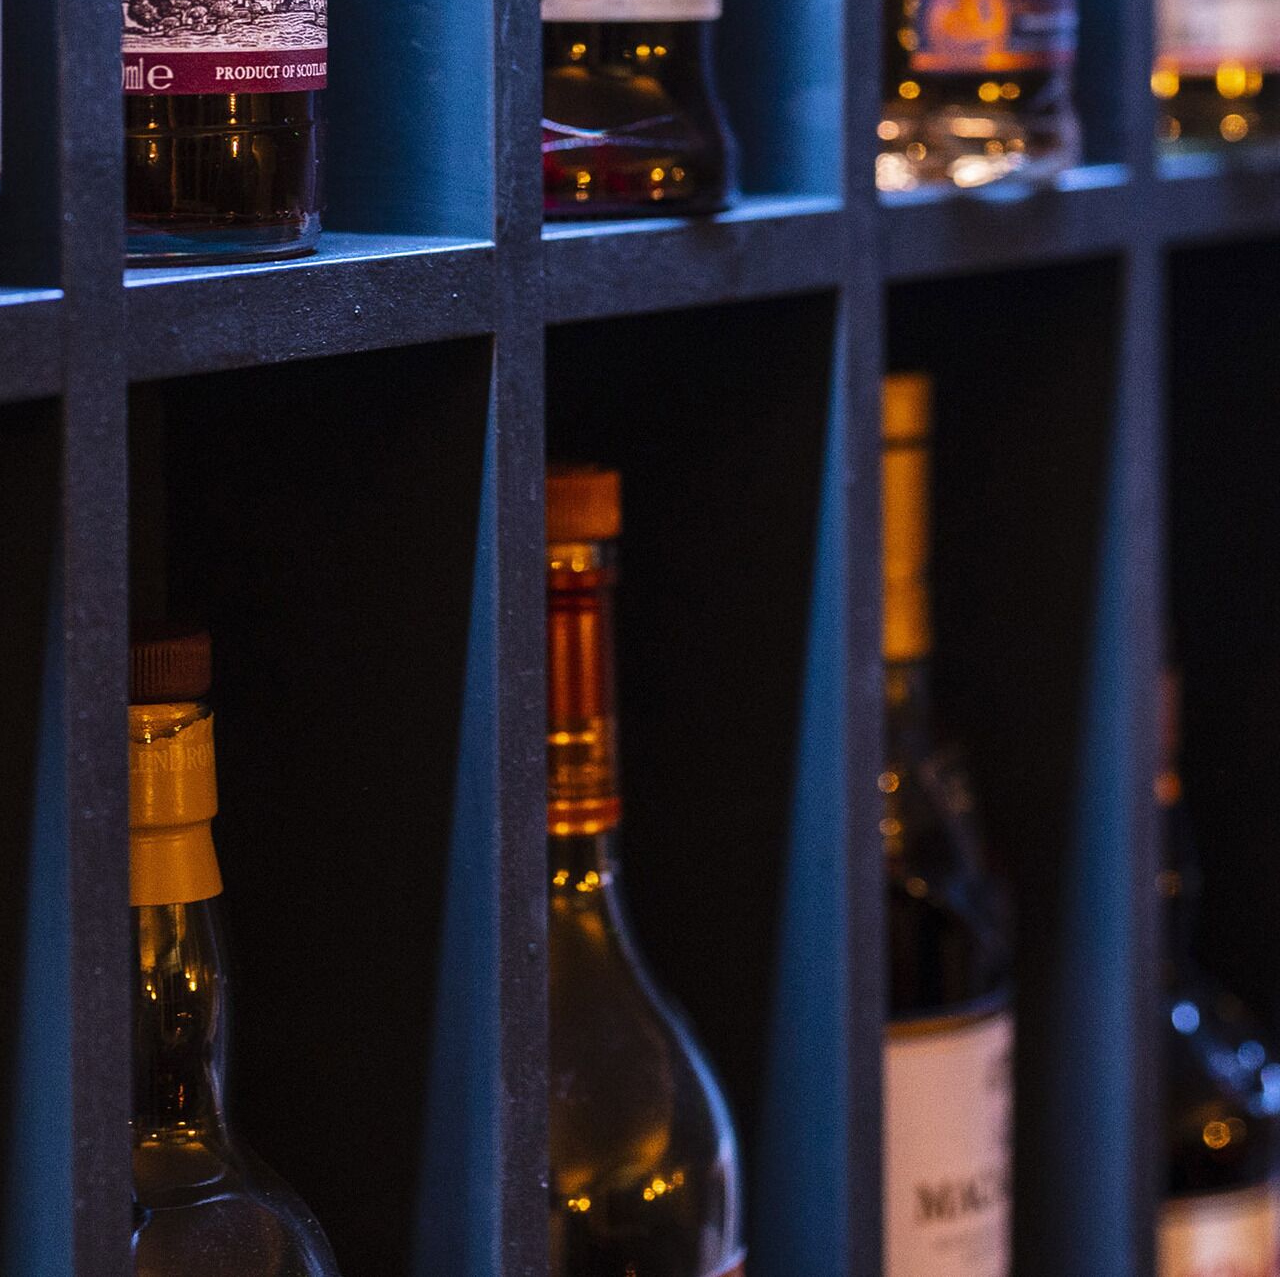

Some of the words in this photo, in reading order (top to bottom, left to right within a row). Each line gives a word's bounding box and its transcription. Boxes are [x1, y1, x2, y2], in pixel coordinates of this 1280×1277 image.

[120, 56, 144, 90] ml
[215, 65, 281, 81] PRODUCT
[281, 64, 296, 79] OF
